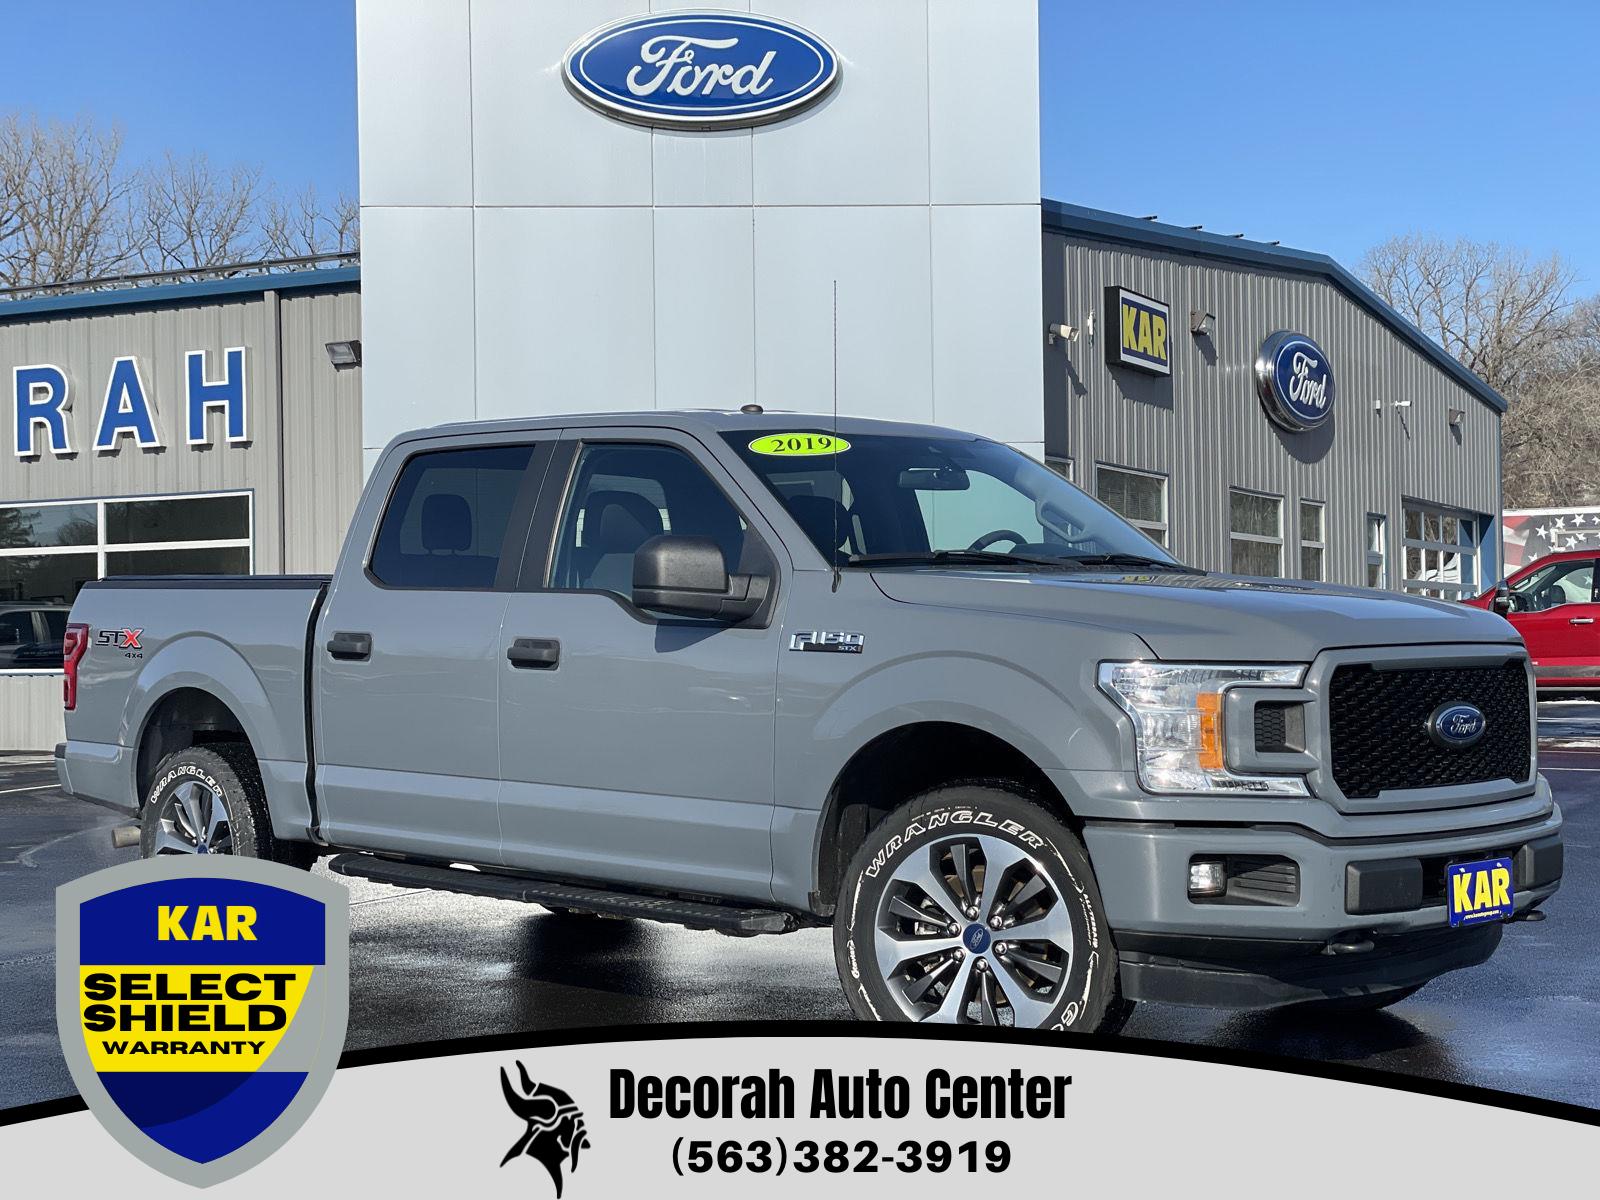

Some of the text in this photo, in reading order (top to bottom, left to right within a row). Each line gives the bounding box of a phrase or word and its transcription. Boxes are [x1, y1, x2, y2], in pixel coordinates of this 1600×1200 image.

[626, 35, 776, 96] Ford
[1122, 303, 1167, 361] KAR
[13, 346, 246, 456] RAH
[1289, 351, 1327, 409] Ford
[771, 437, 832, 452] 2019
[96, 628, 143, 648] STX
[1450, 713, 1477, 734] Ford
[150, 765, 223, 804] WRANGLER
[865, 810, 1044, 878] WRANGLER
[1453, 867, 1511, 914] KAR
